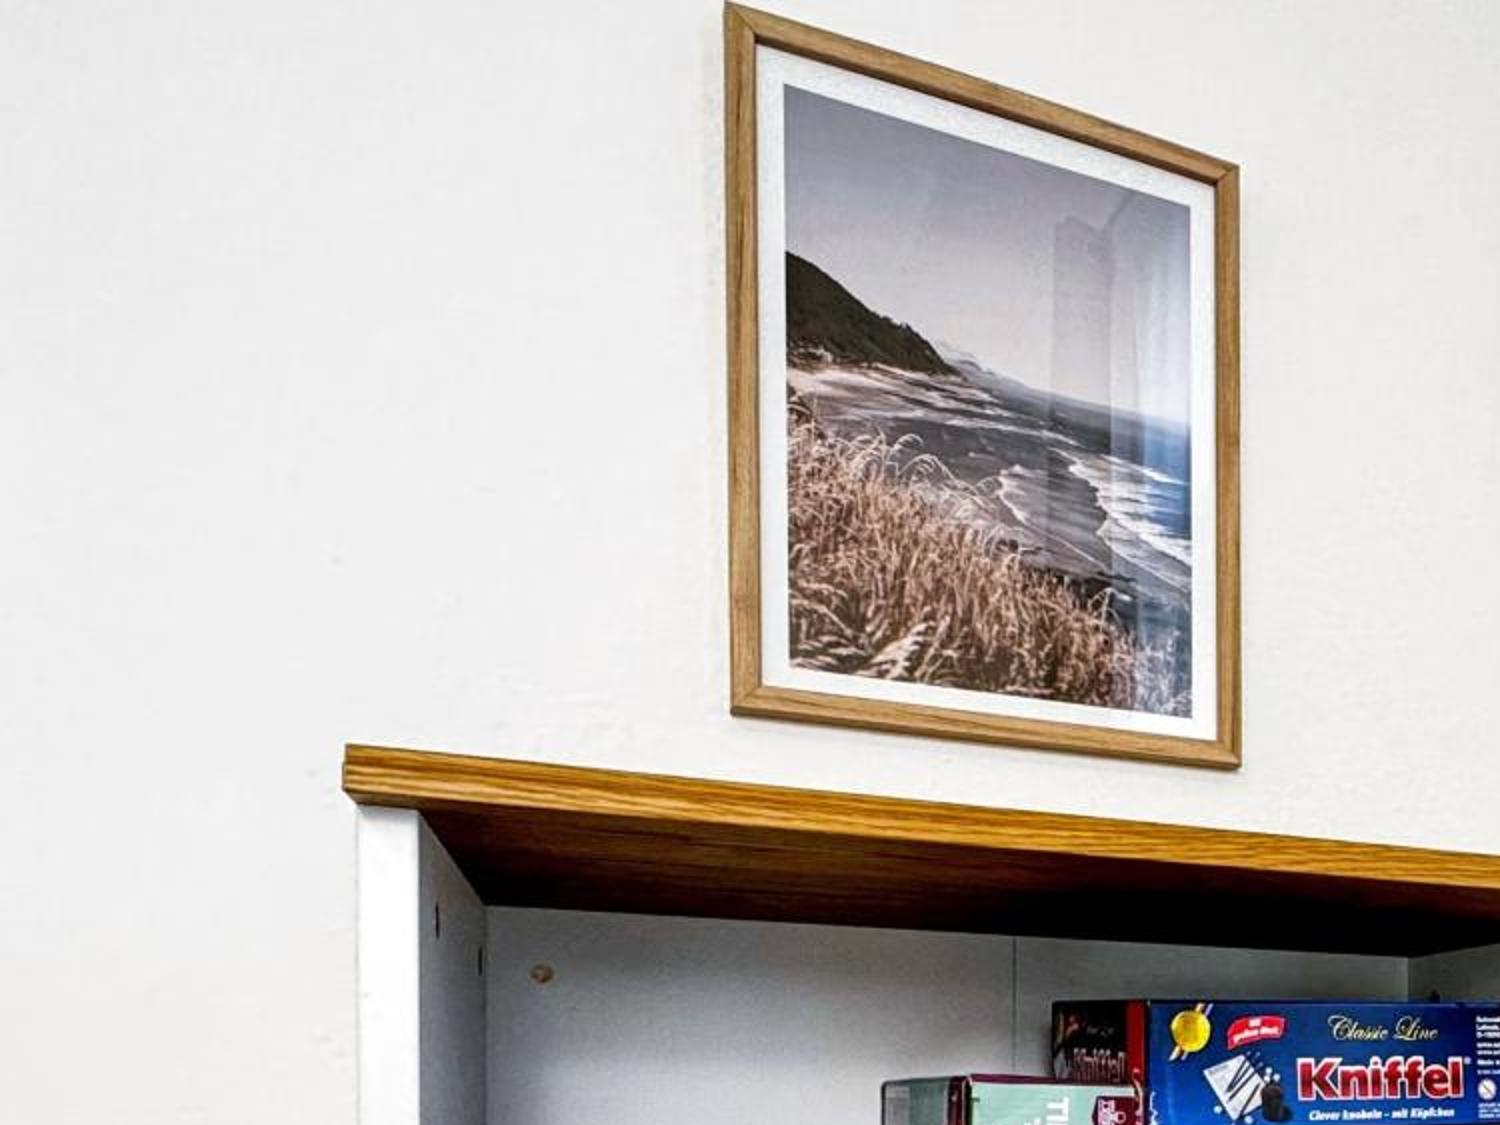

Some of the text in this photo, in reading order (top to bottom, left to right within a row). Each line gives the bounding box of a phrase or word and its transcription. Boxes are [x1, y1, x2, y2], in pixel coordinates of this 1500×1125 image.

[1328, 1014, 1438, 1041] Classic Line
[1296, 1056, 1465, 1101] Kniffel
